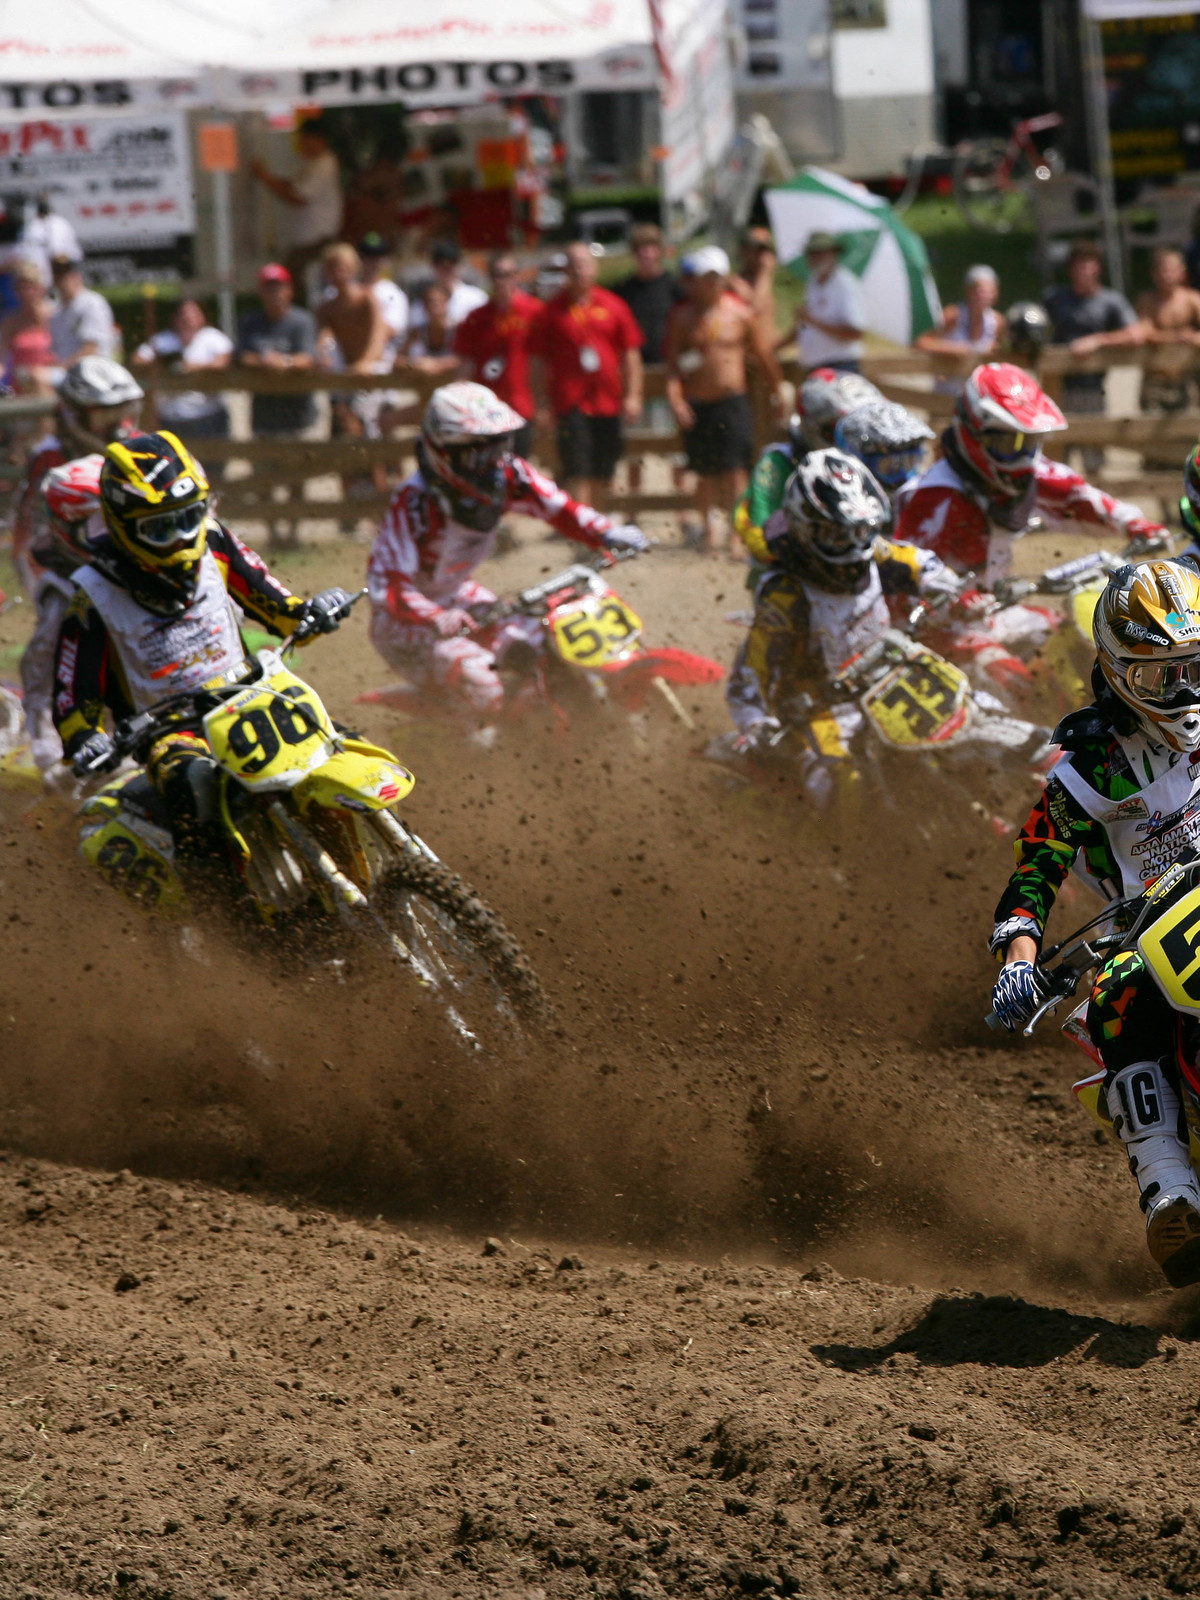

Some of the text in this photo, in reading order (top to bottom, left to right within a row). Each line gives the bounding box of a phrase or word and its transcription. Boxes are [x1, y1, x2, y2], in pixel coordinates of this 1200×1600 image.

[303, 58, 576, 94] PHOTOS
[560, 604, 636, 659] 53
[1146, 631, 1170, 647] OGIO
[227, 686, 320, 774] 96
[1131, 838, 1160, 856] AMA
